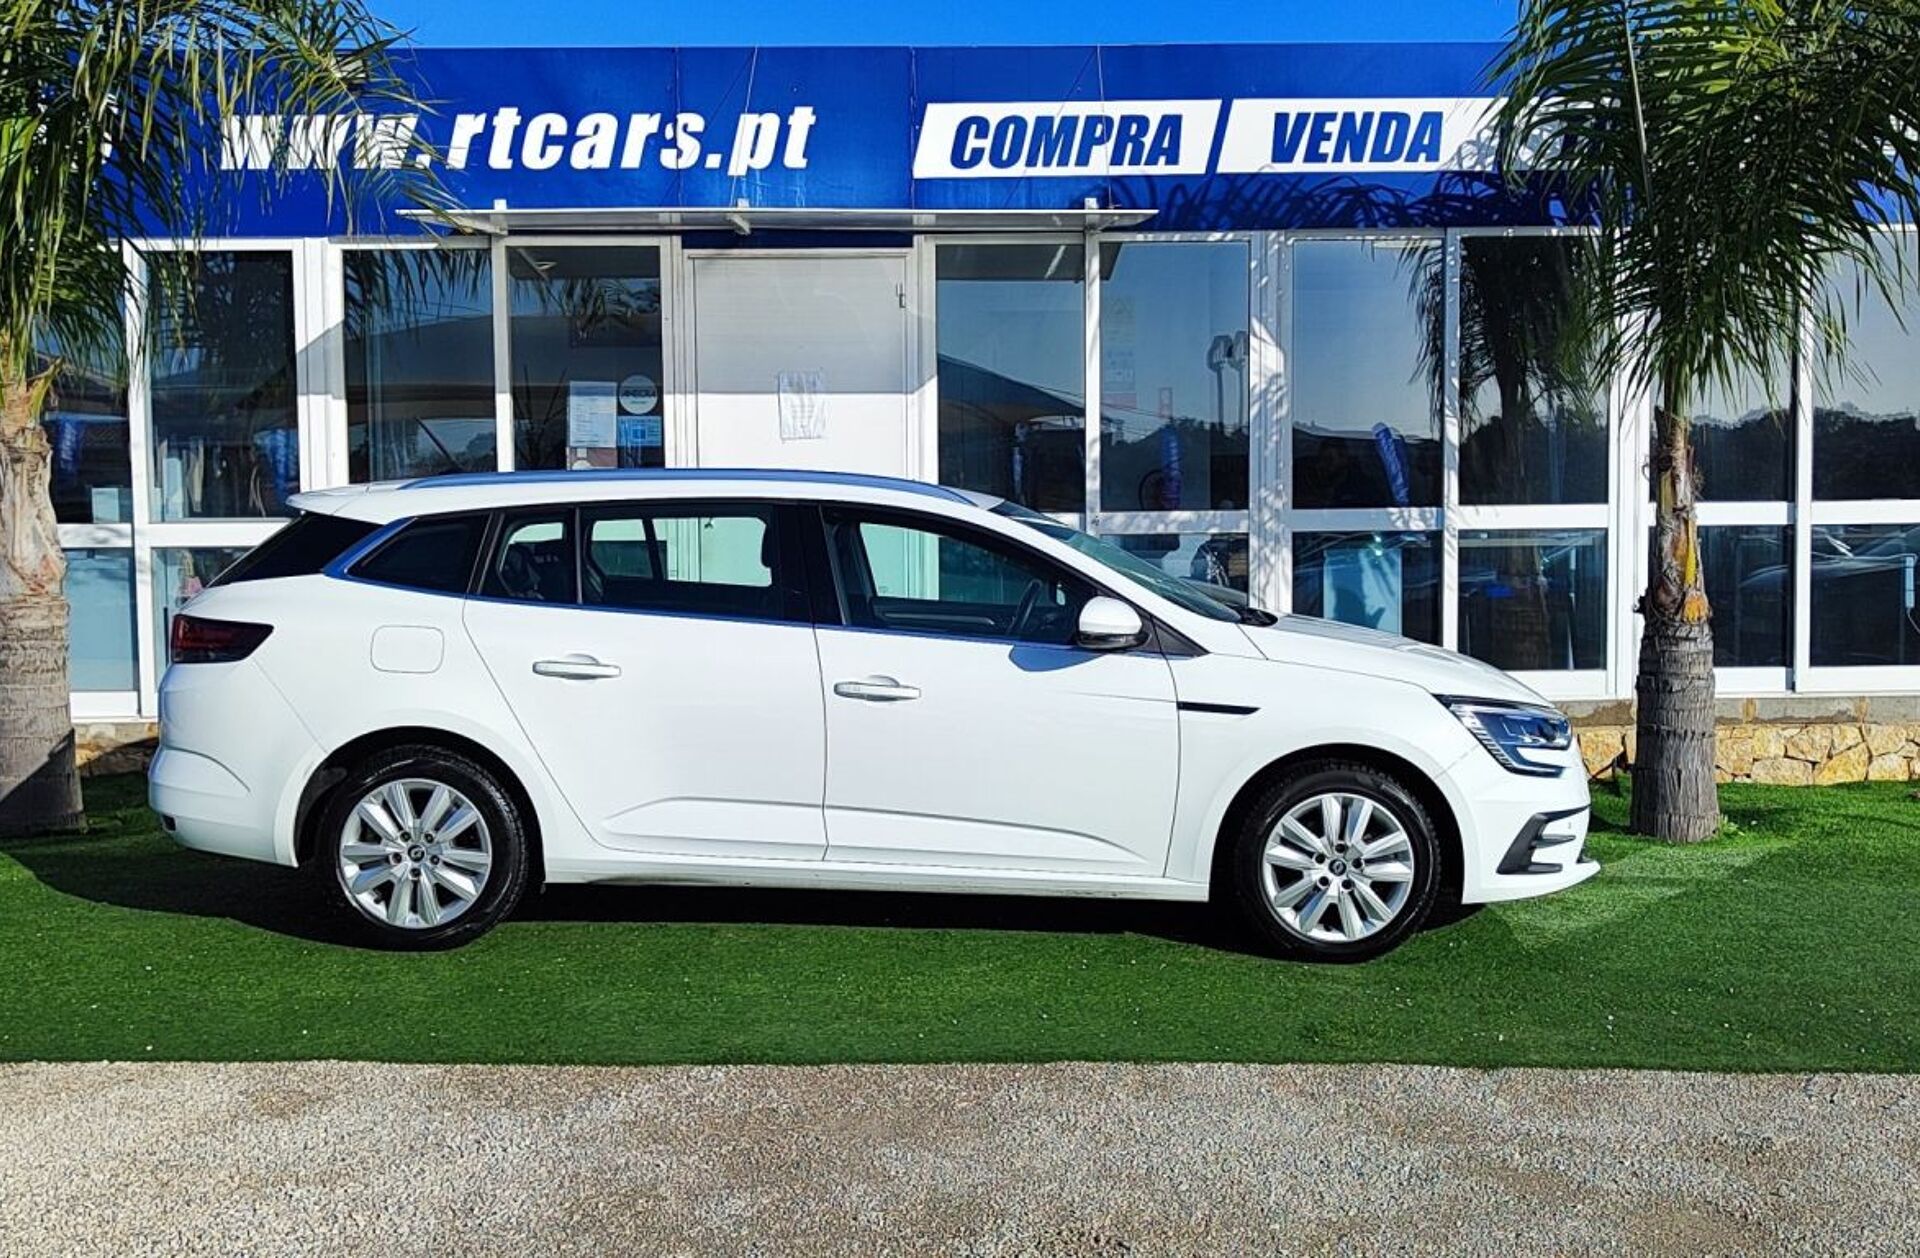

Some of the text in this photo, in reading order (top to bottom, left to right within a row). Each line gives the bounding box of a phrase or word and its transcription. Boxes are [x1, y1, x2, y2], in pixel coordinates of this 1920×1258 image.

[219, 106, 817, 176] www.rtcars.pt
[950, 114, 1184, 170] COMPRA
[1271, 111, 1444, 164] VENDA
